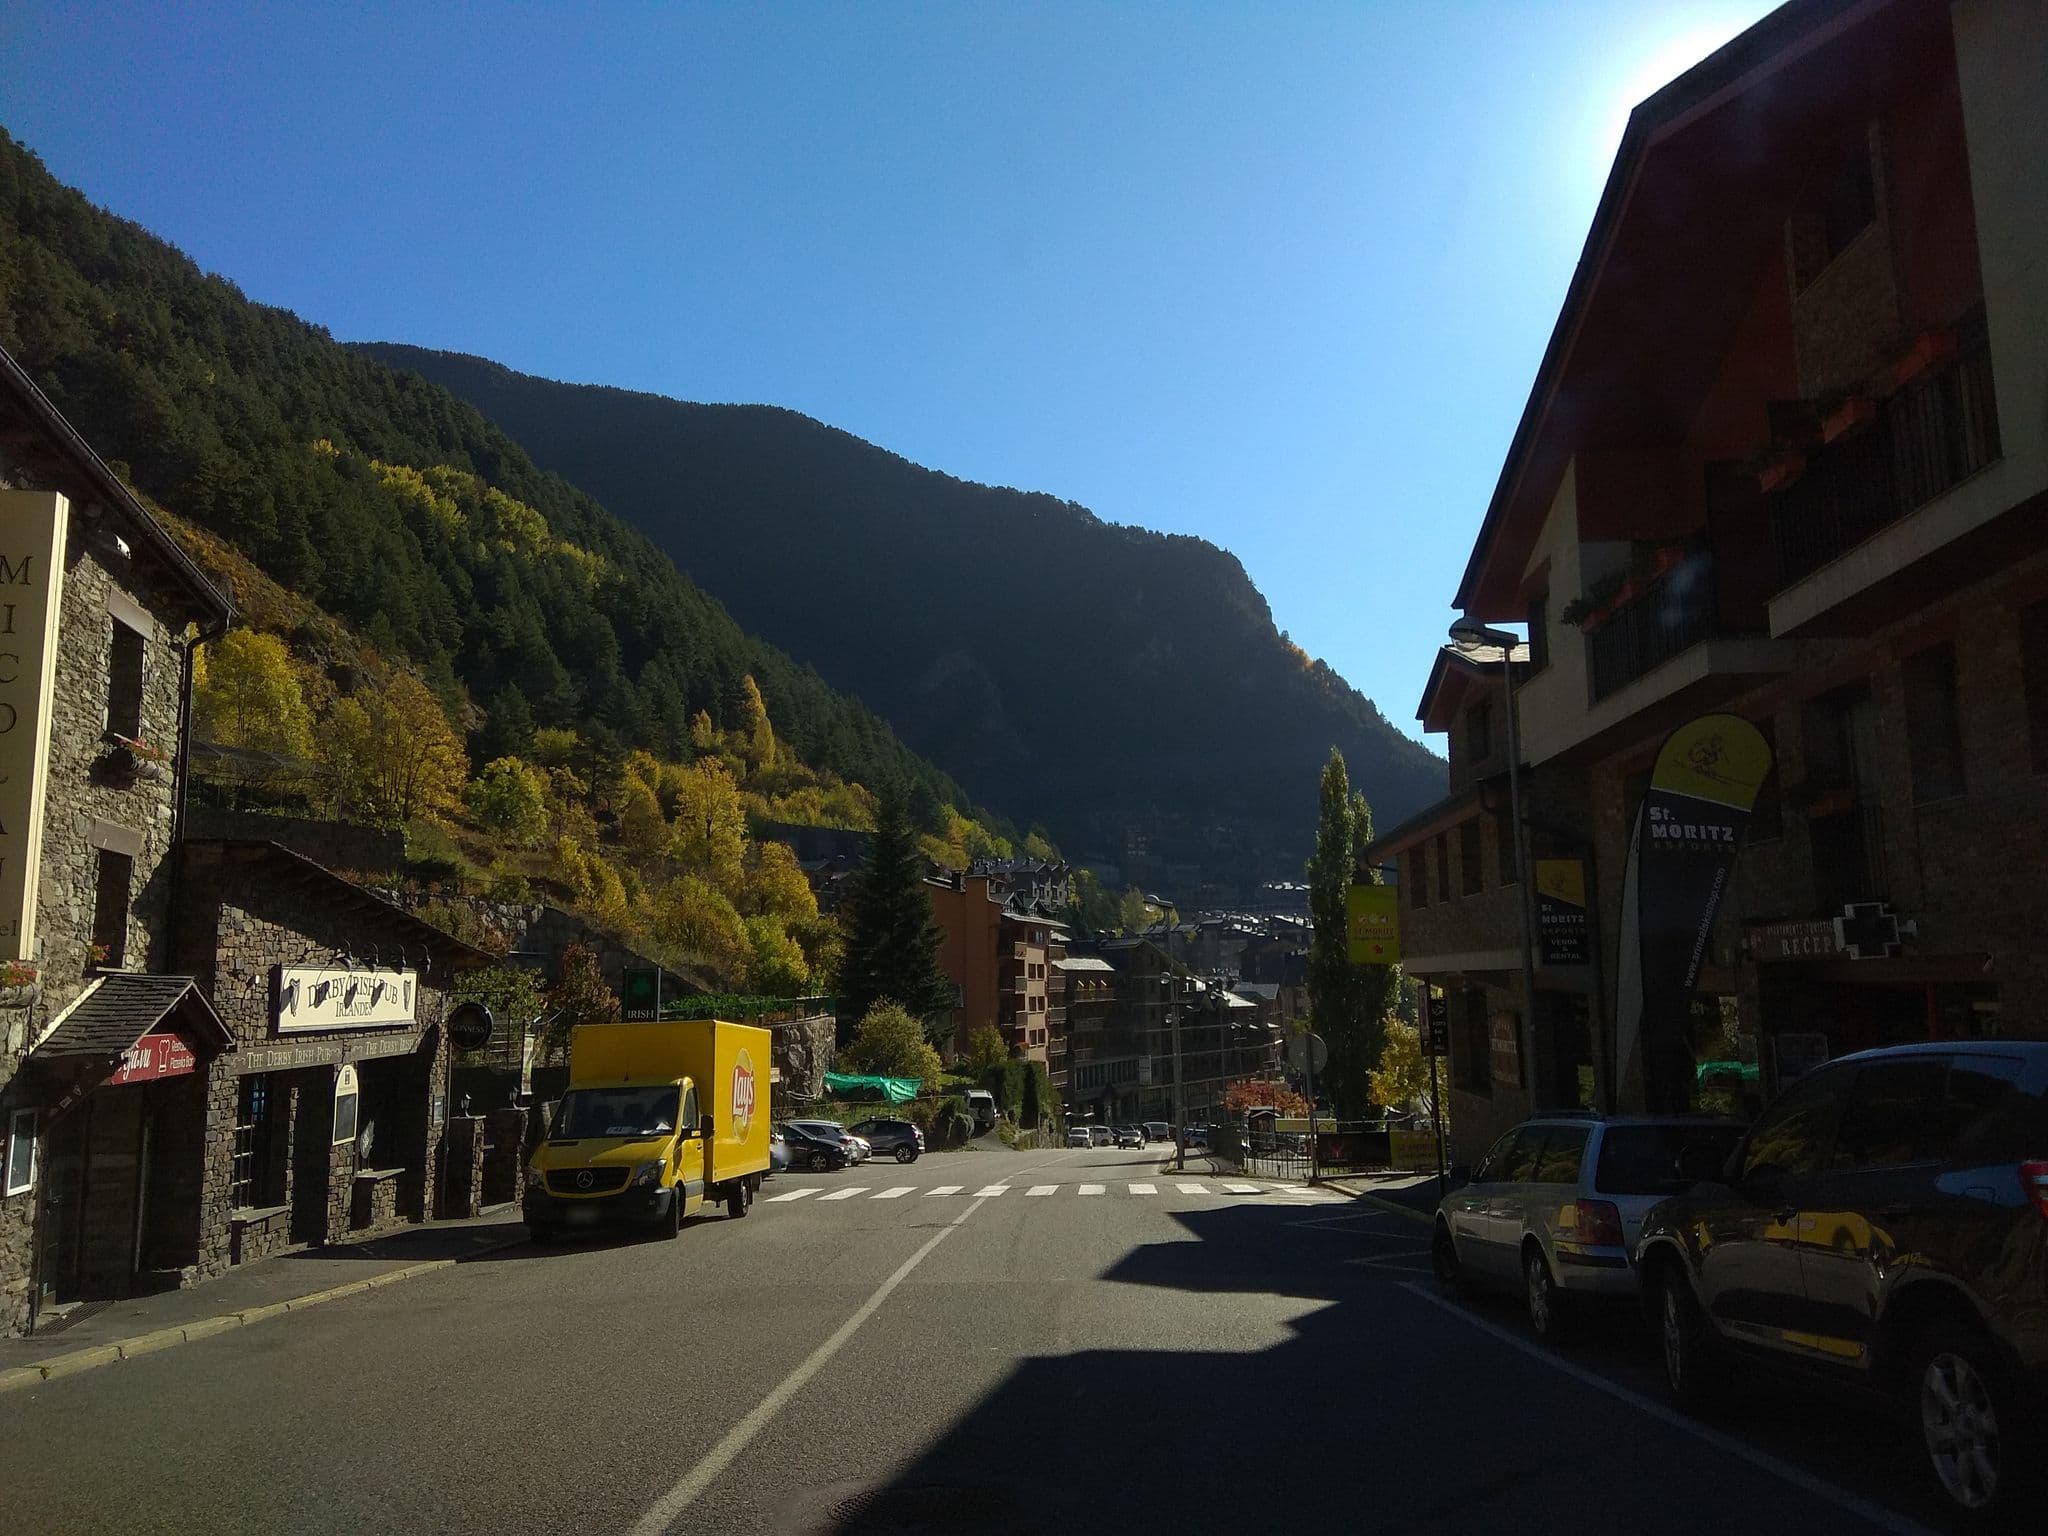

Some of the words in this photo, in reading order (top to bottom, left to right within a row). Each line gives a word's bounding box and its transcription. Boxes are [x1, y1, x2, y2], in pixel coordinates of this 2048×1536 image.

[1651, 823, 1734, 842] MORITZ
[1542, 914, 1585, 924] MORITZ
[307, 977, 346, 1008] DERBY
[348, 974, 376, 996] IRISH
[377, 979, 398, 1004] PUB
[627, 1010, 654, 1019] IRISH
[246, 1051, 263, 1069] THE
[267, 1049, 292, 1067] DERBY
[295, 1048, 314, 1064] IRISH
[317, 1046, 331, 1061] PUB
